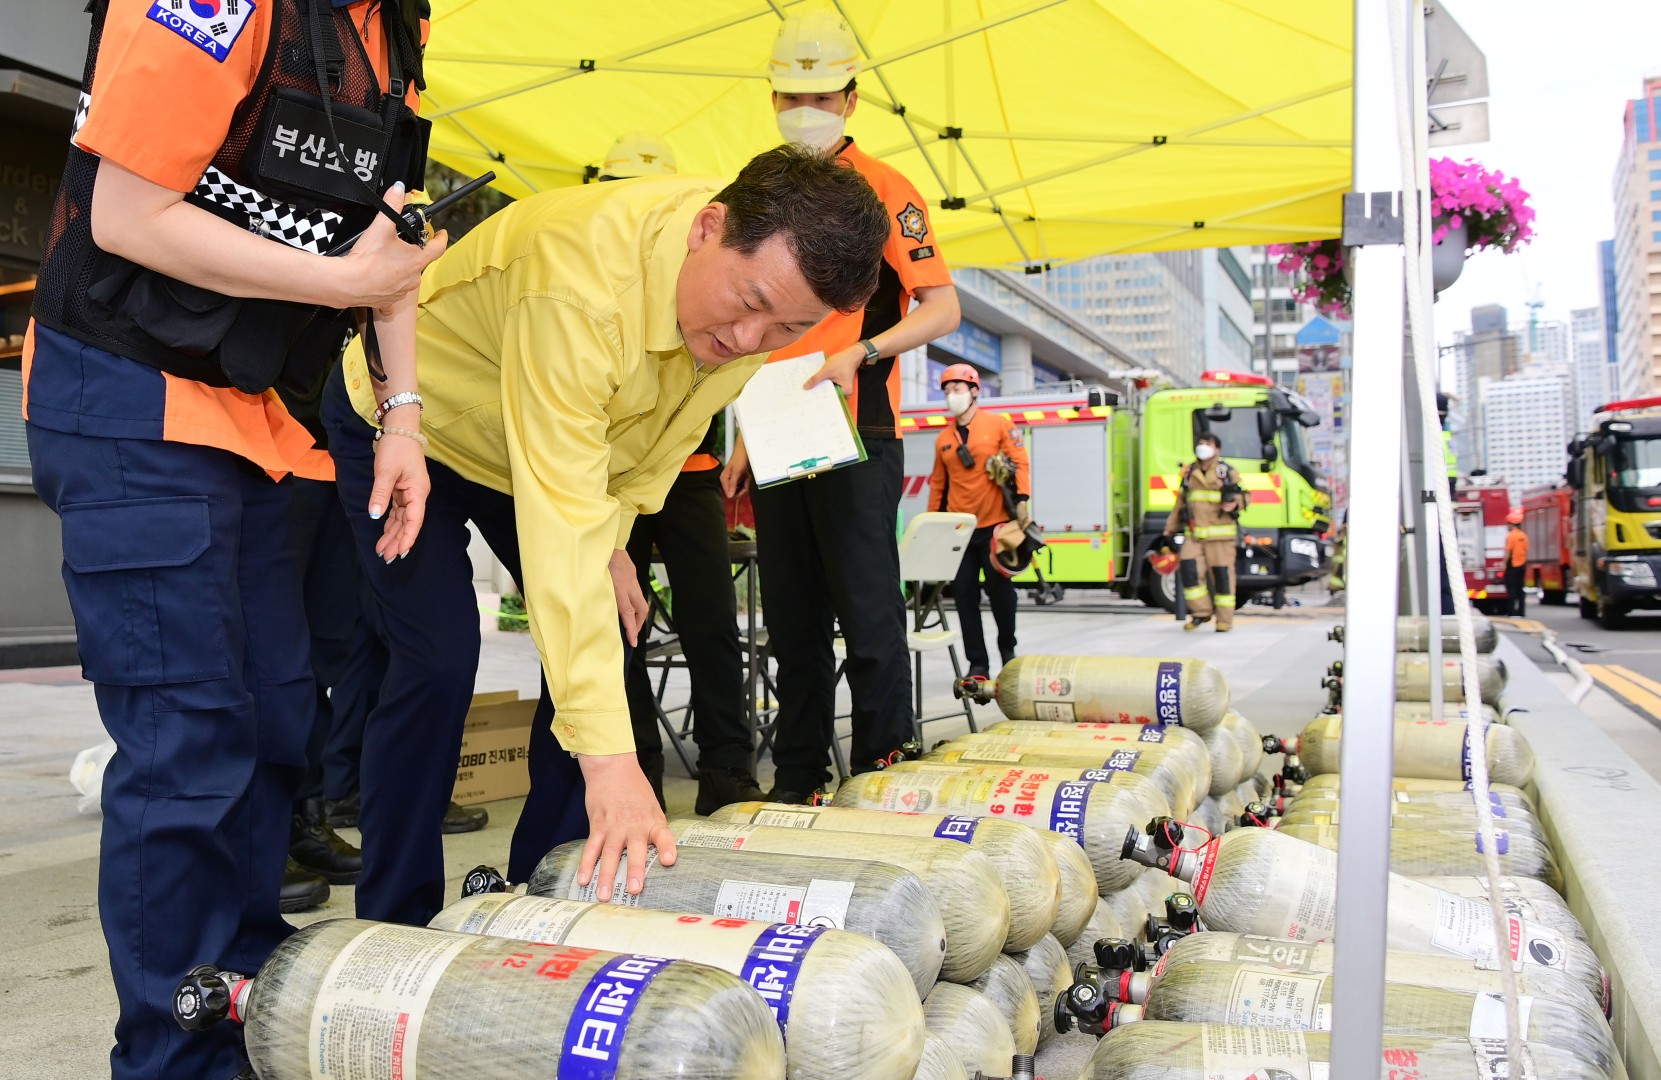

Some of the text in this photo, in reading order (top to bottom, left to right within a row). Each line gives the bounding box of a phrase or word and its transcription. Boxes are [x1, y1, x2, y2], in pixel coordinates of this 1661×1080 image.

[156, 8, 219, 54] KOREA
[272, 124, 378, 182] 부산소방
[990, 803, 1005, 814] 9
[1013, 773, 1050, 816] 충전기한
[1288, 922, 1299, 938] 300
[501, 952, 535, 968] 12
[1294, 997, 1305, 1025] DOT-SP
[319, 1026, 327, 1075] SanCheong
[393, 1022, 404, 1052] 실린더
